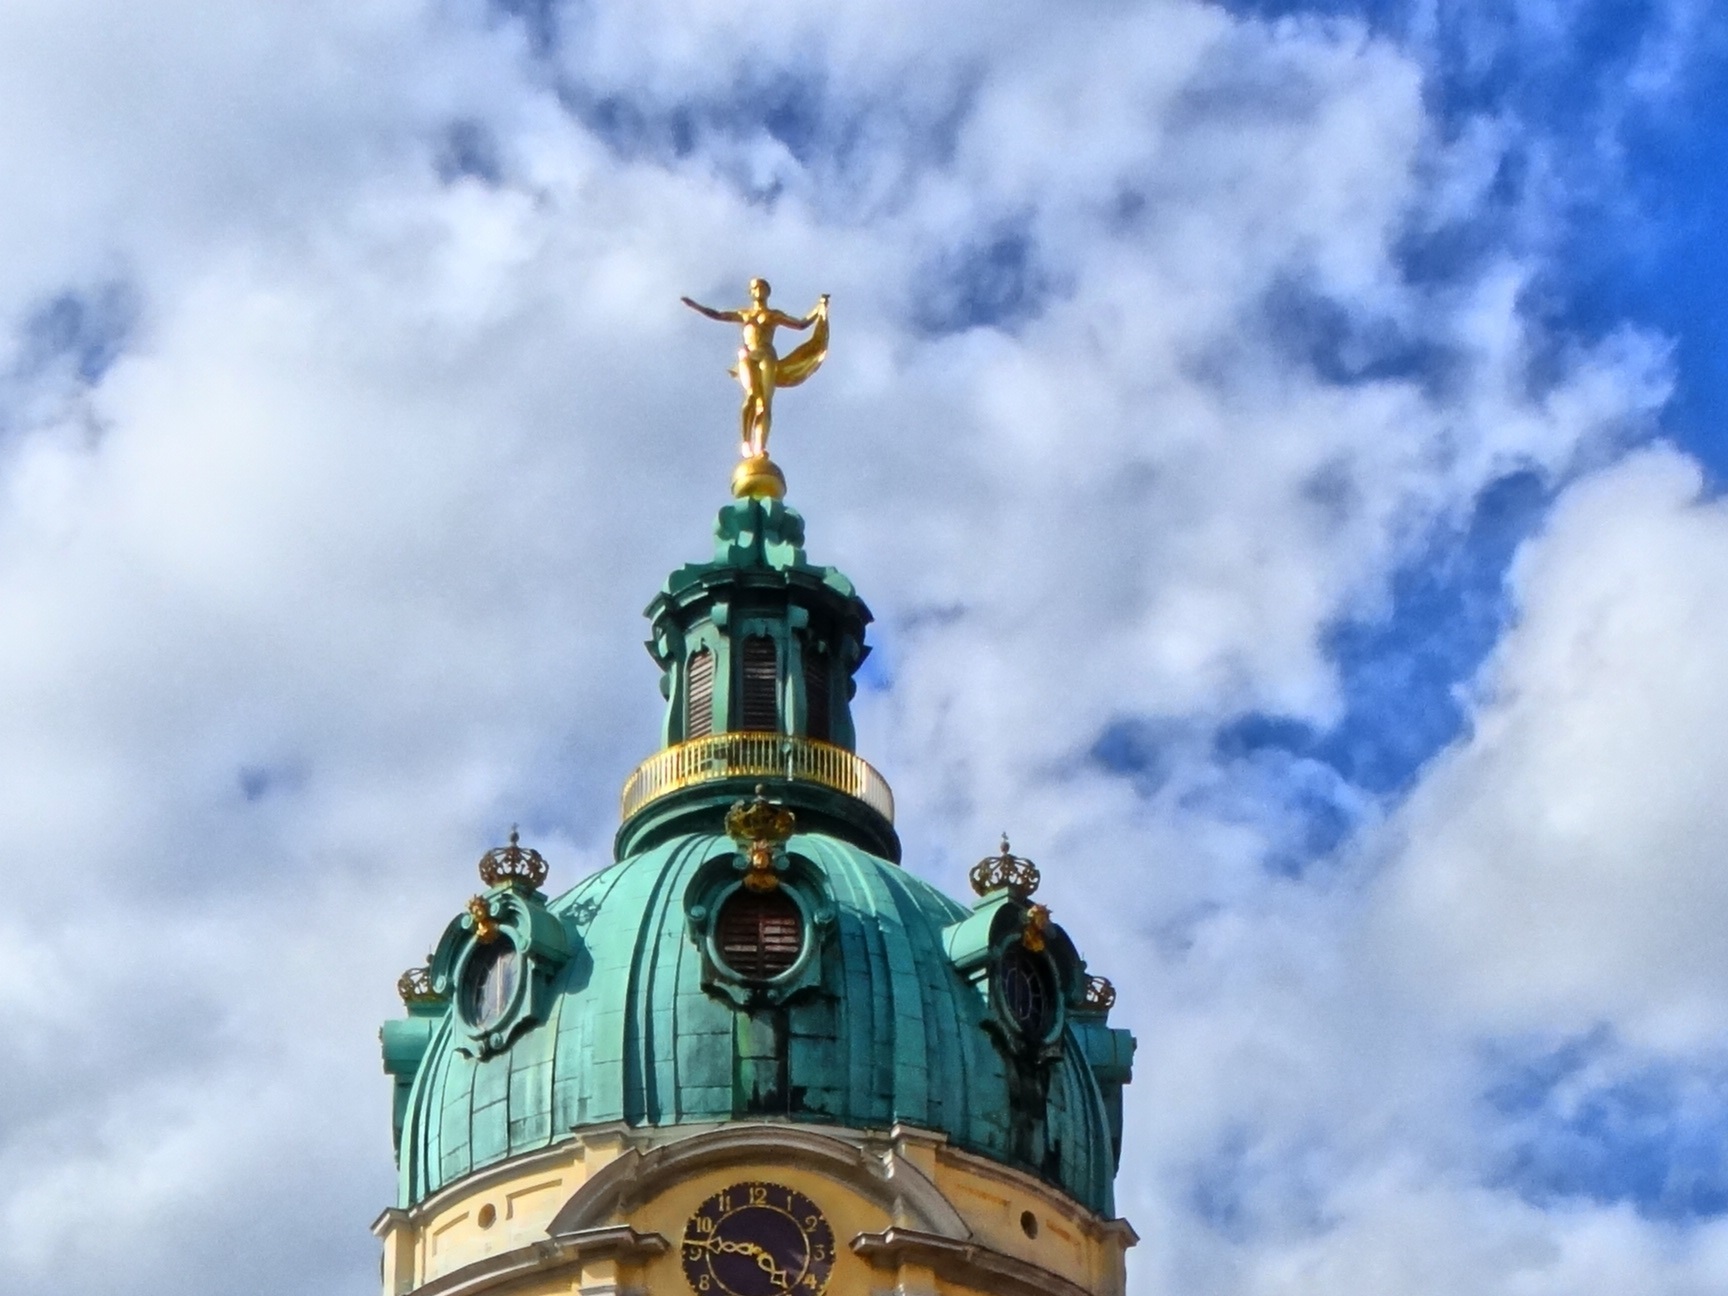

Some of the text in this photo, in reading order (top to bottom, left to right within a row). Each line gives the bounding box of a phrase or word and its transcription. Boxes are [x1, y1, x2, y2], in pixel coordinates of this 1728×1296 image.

[719, 1195, 731, 1211] 11
[749, 1187, 767, 1204] 12
[787, 1196, 792, 1211] 1
[696, 1218, 712, 1232] 10
[805, 1216, 817, 1232] 2
[689, 1247, 702, 1261] 9
[814, 1246, 825, 1261] 3
[699, 1274, 710, 1290] 8
[803, 1274, 817, 1289] 4
